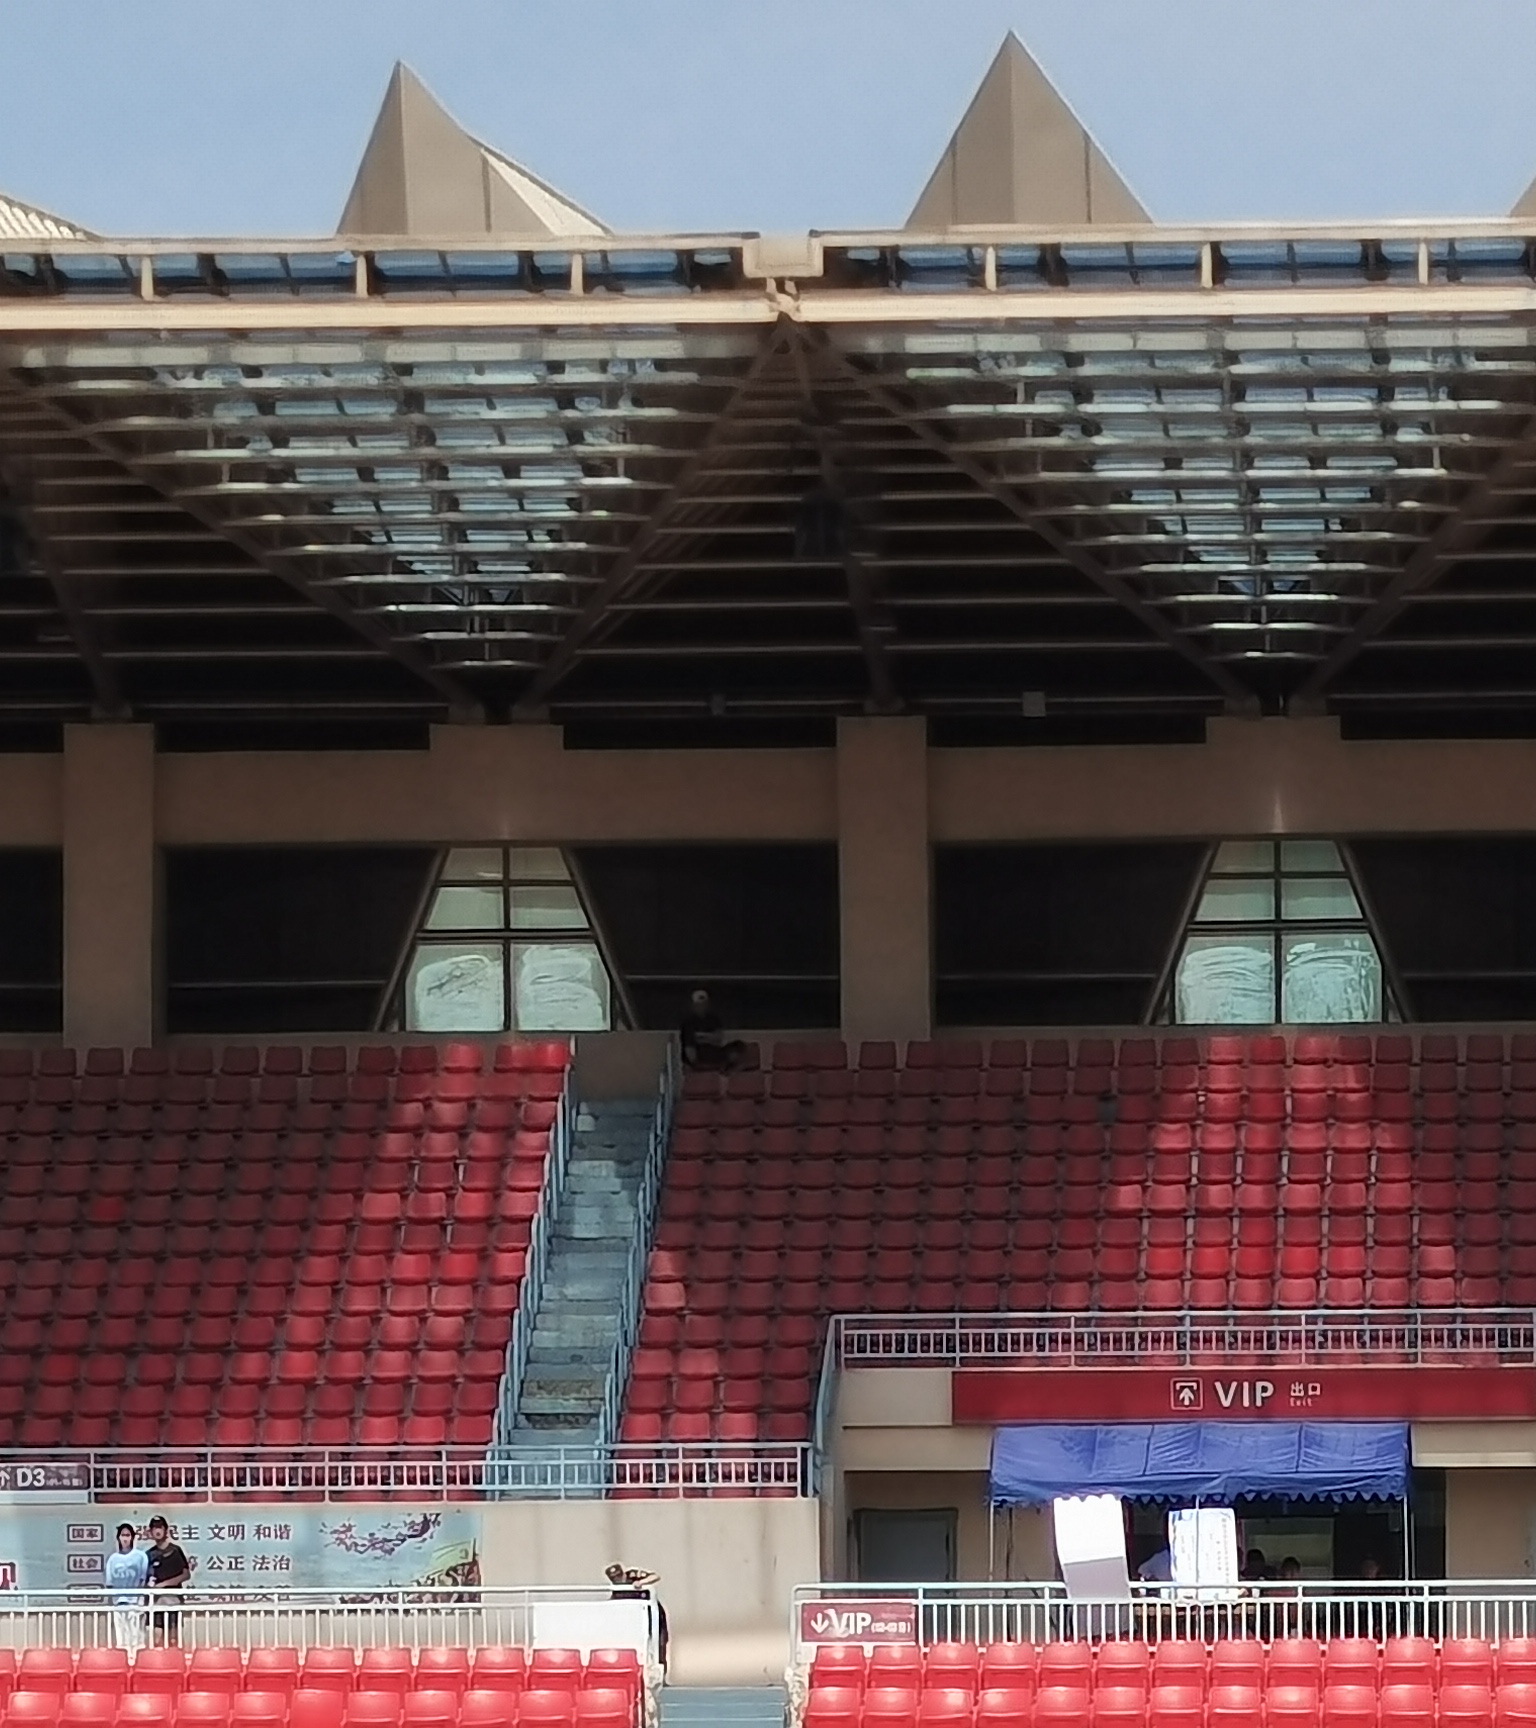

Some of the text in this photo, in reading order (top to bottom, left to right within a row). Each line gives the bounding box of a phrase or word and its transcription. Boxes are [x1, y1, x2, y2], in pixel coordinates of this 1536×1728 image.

[1213, 1381, 1275, 1408] VIP
[1289, 1381, 1322, 1397] 出口
[16, 1467, 46, 1487] D3
[71, 1528, 98, 1540] 国家
[207, 1523, 246, 1541] 文明
[252, 1523, 292, 1541] 和谐
[71, 1557, 98, 1569] 社会
[206, 1555, 246, 1572] 公正
[252, 1555, 292, 1572] 法治
[824, 1609, 871, 1635] VIP
